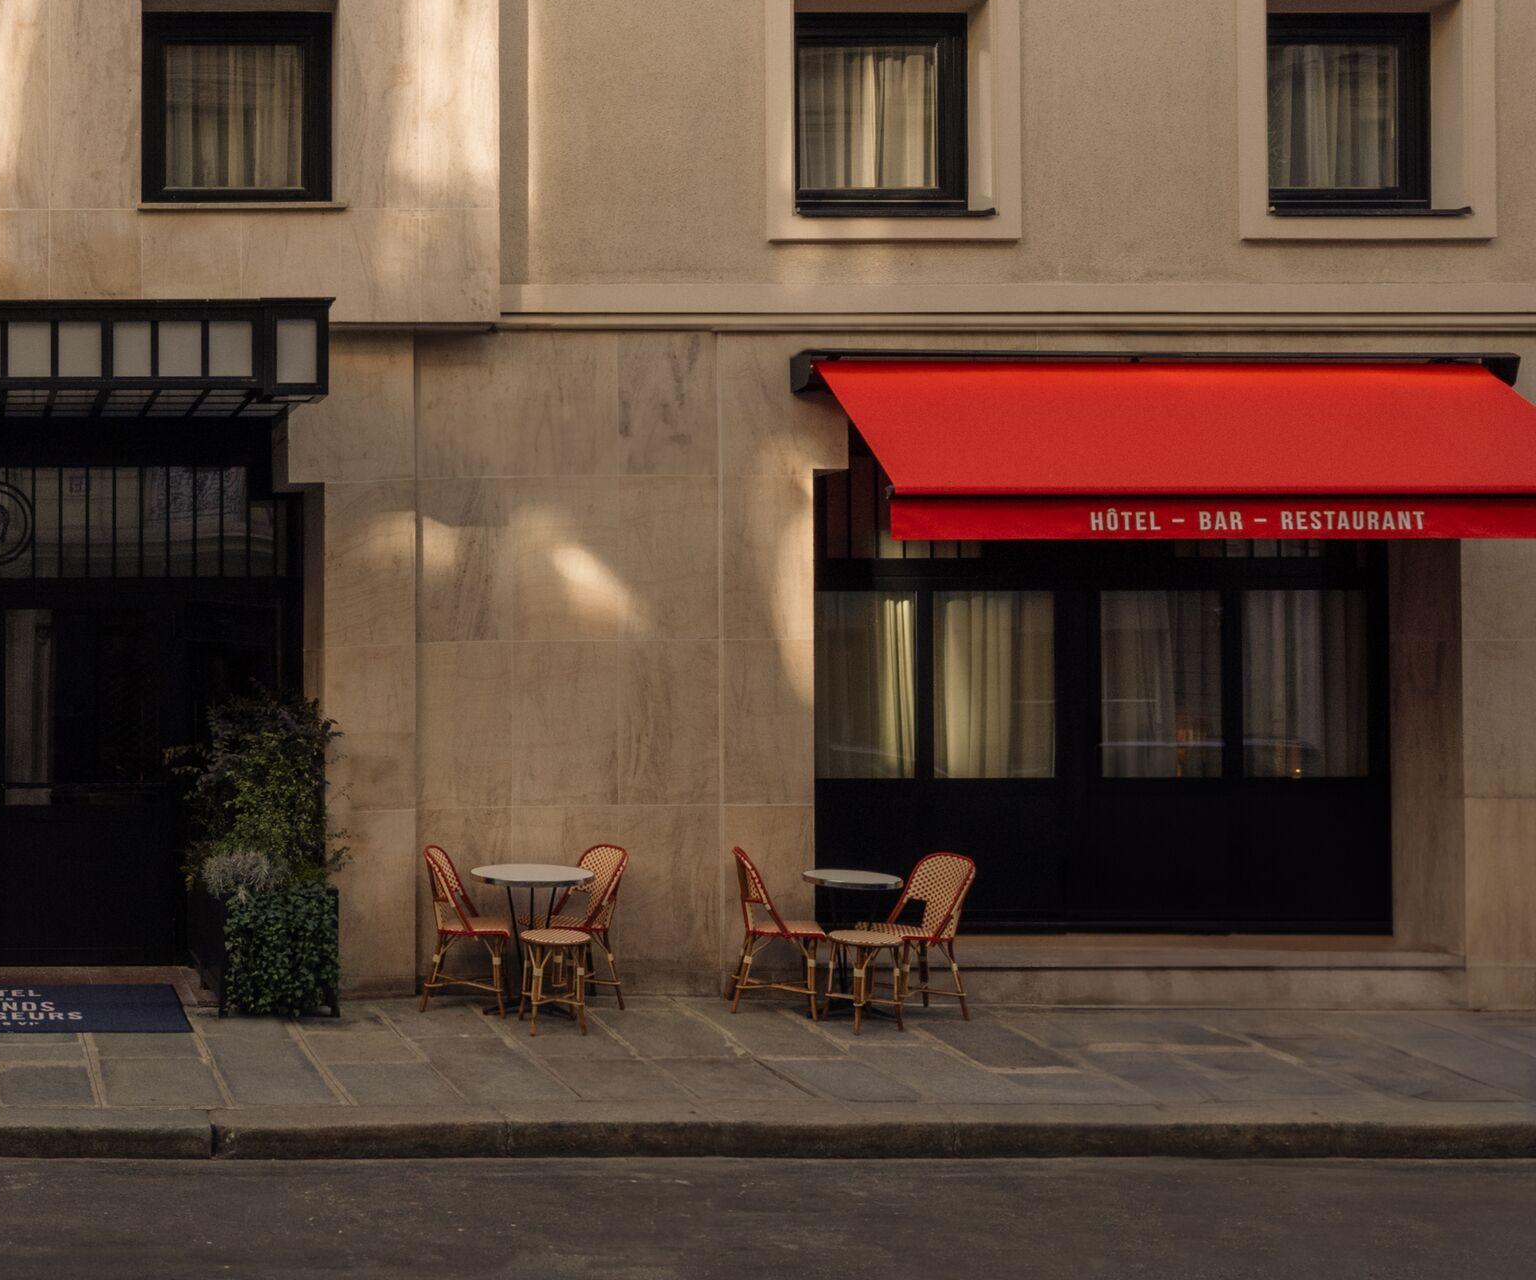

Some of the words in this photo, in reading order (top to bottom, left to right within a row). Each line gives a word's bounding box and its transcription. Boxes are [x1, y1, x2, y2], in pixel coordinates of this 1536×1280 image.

[1090, 507, 1161, 531] HÔTEL
[1199, 511, 1244, 531] BAR
[1280, 510, 1425, 530] RESTAURANT
